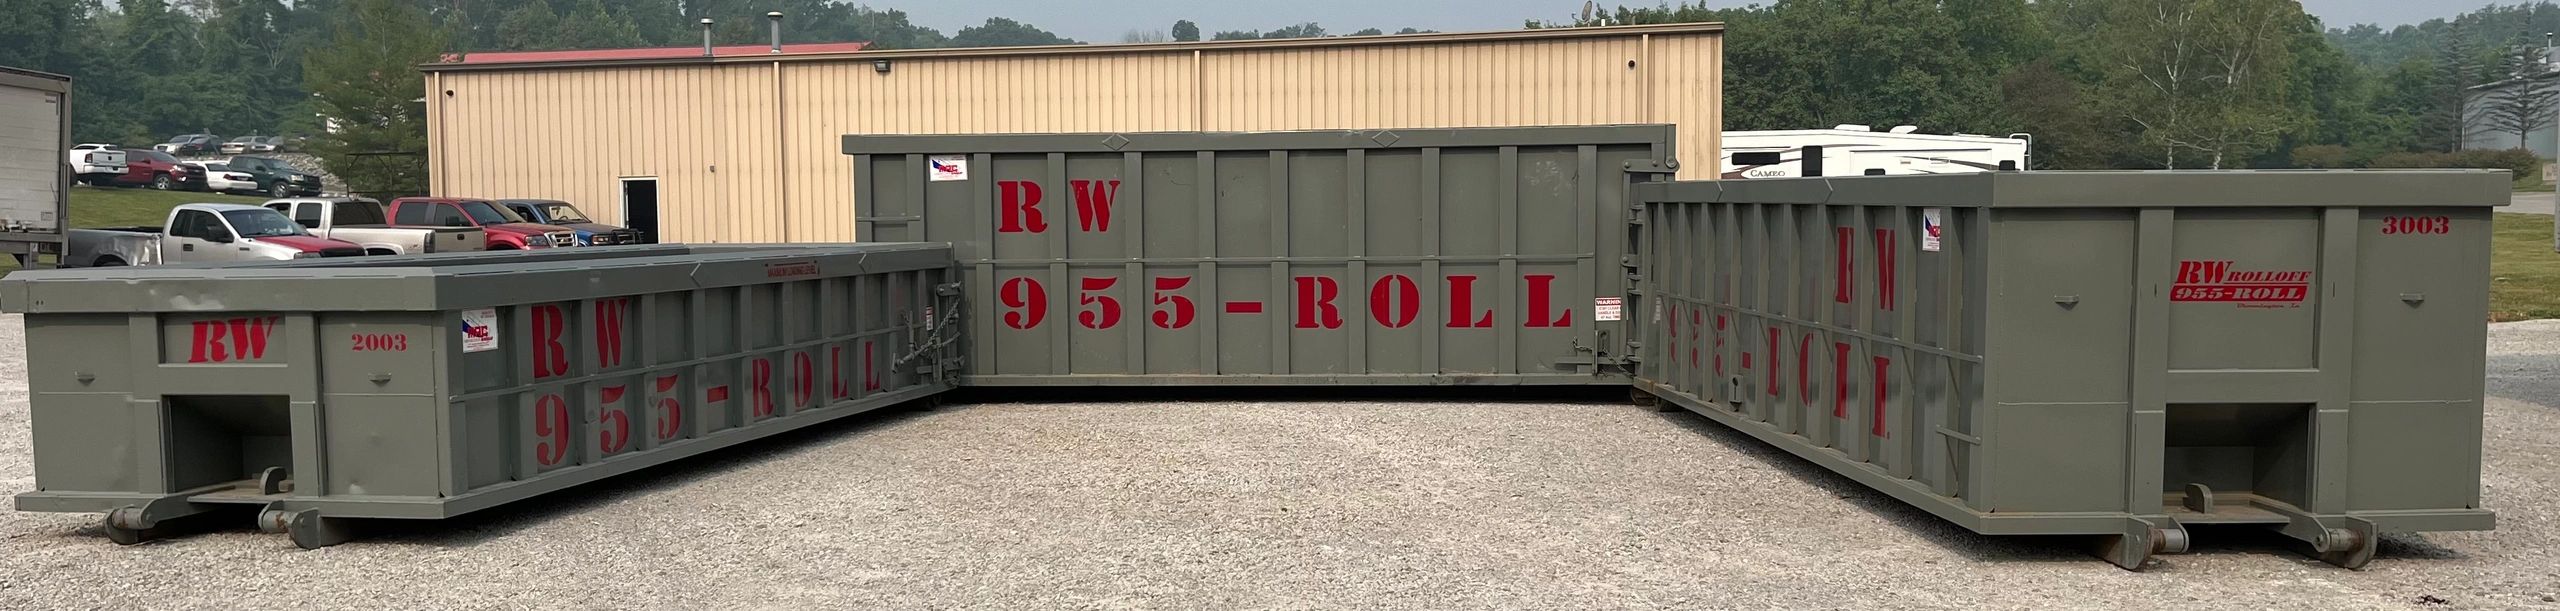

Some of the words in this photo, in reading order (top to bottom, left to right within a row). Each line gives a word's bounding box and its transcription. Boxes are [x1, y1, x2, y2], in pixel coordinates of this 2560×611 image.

[1750, 169, 1786, 178] CAMEO
[997, 179, 1121, 234] RW
[2382, 216, 2449, 235] 3003
[2175, 260, 2234, 284] RW
[2226, 270, 2312, 282] ROLLOFF
[2175, 286, 2301, 300] 955-ROLL
[188, 316, 280, 363] RW
[352, 333, 407, 351] 2003
[531, 297, 628, 379] RW
